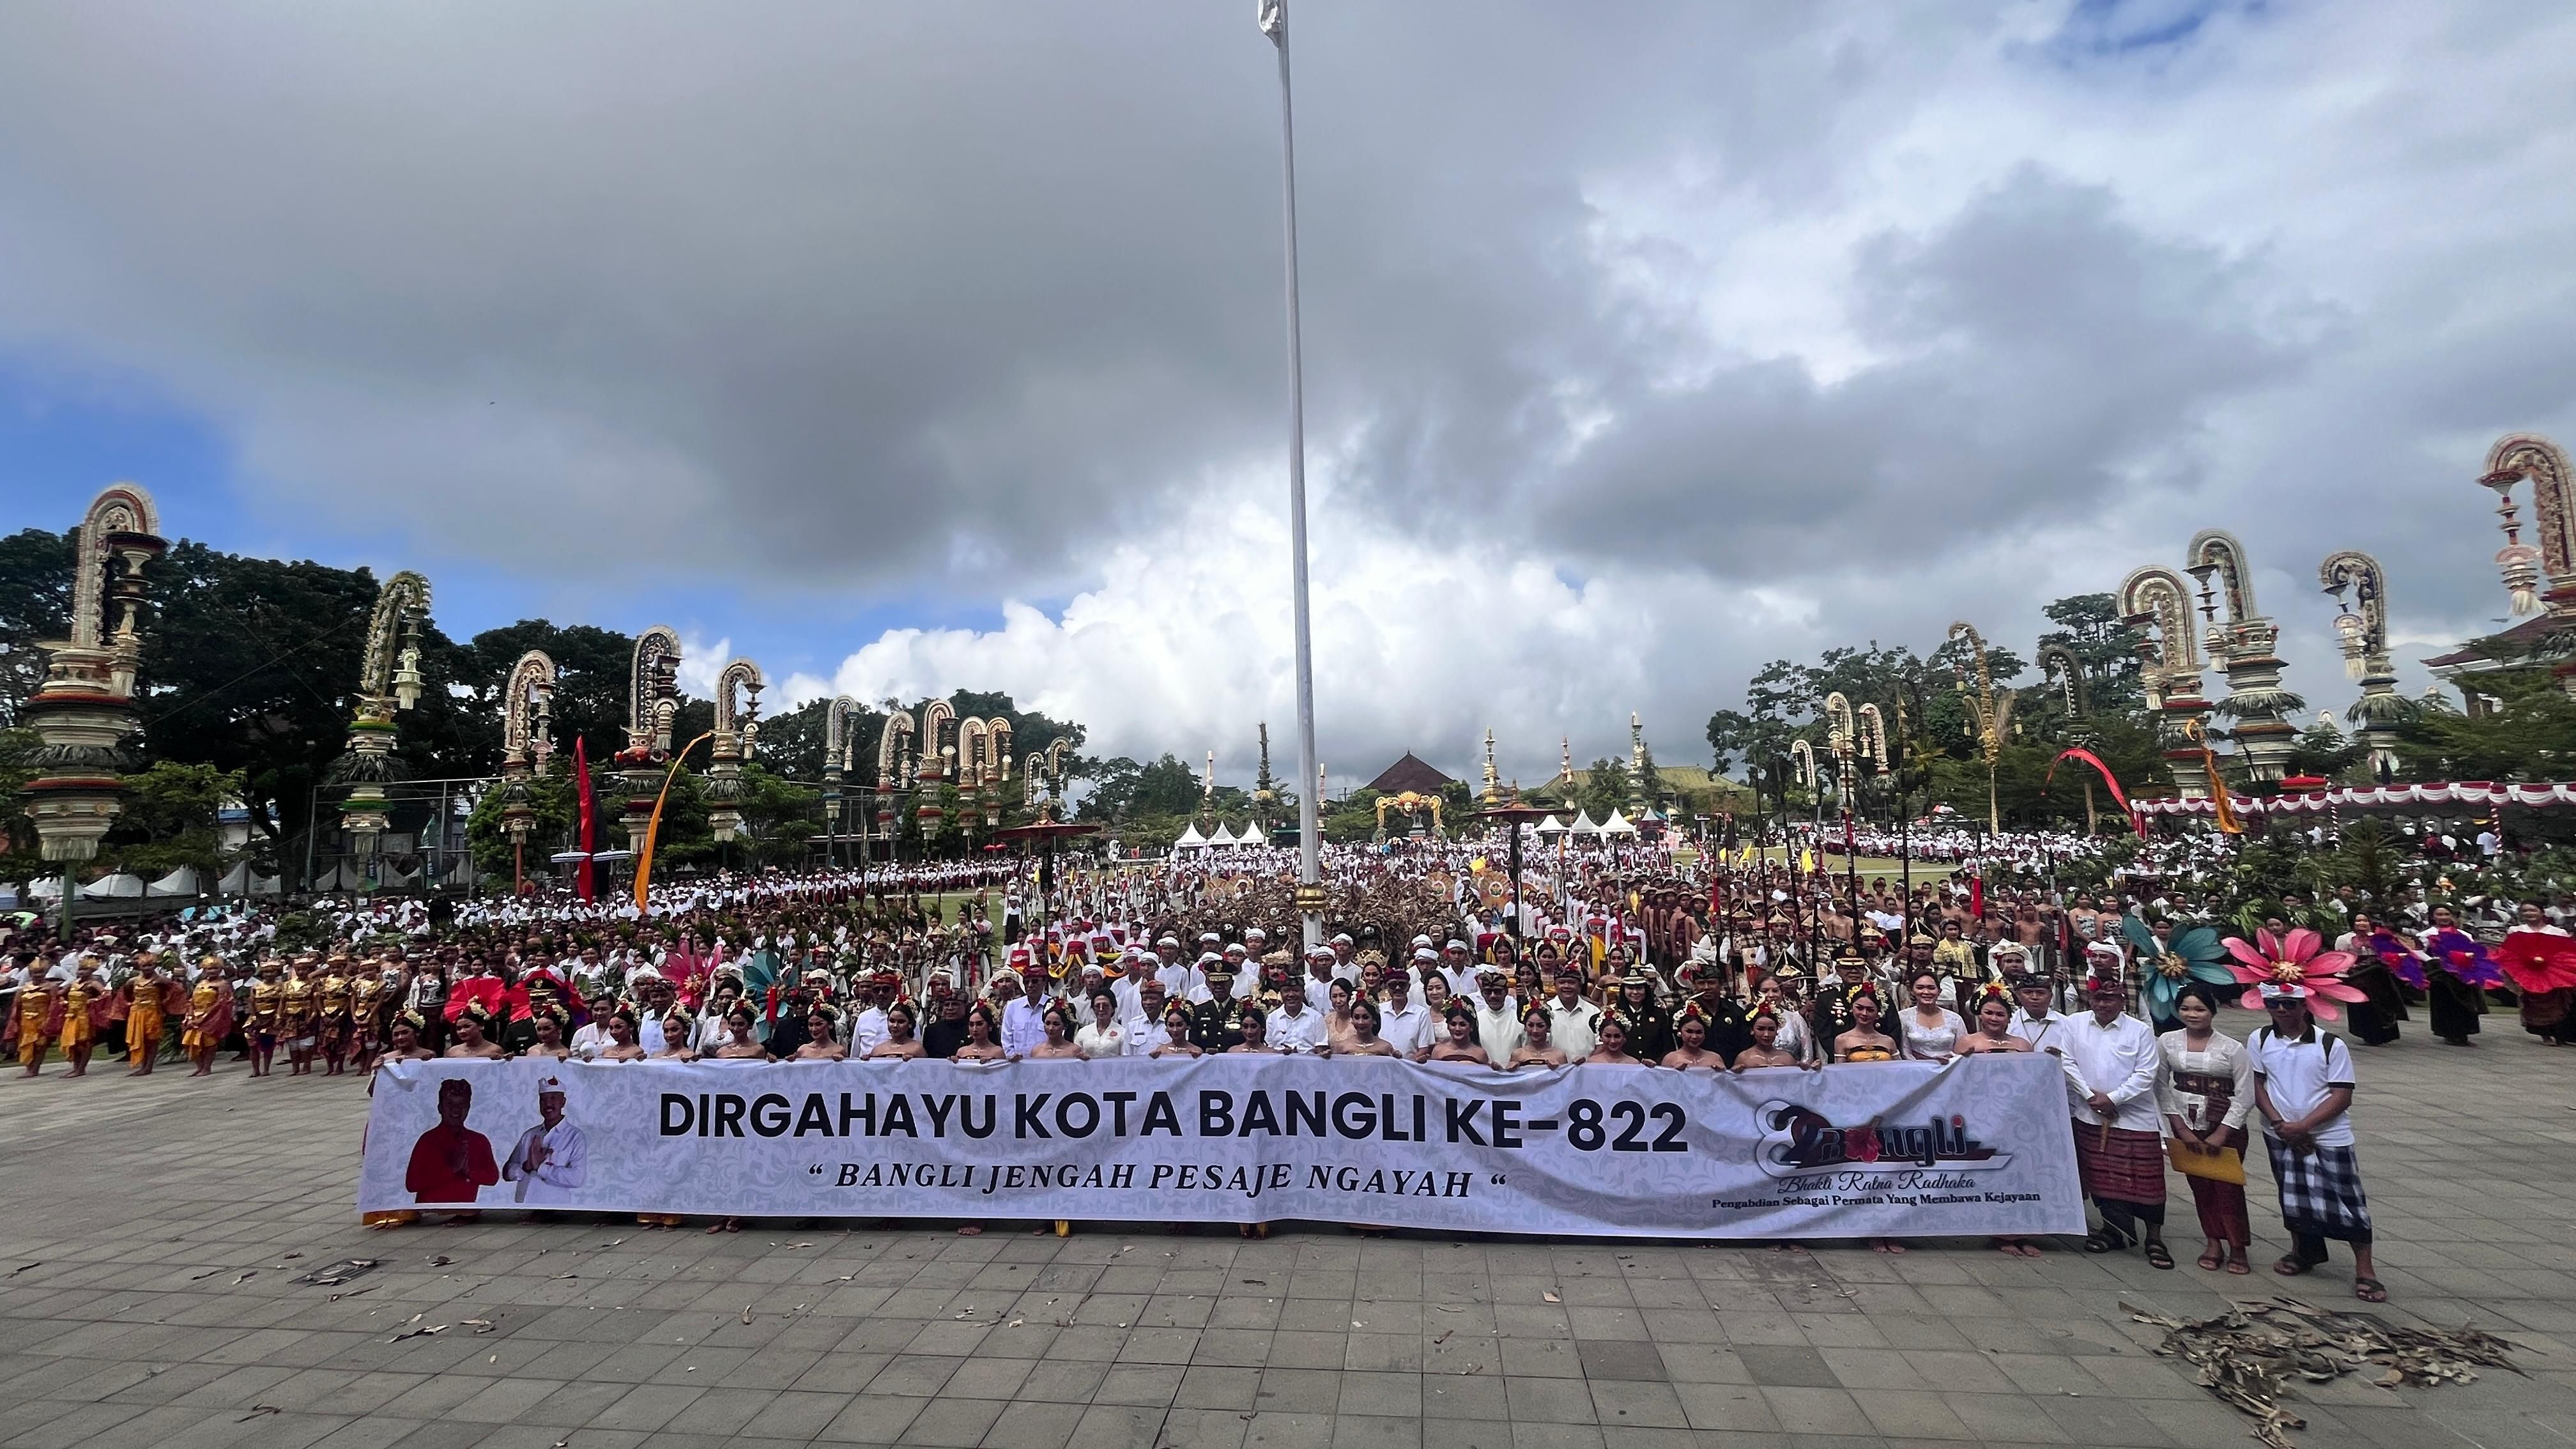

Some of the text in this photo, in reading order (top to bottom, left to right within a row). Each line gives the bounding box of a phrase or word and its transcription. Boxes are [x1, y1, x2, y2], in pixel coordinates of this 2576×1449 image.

[659, 1089, 1689, 1153] DIRGAHAYU KOTA BANGLI KE-822
[834, 1163, 977, 1188] BANGLI
[981, 1164, 1138, 1195] JENGAH
[1147, 1163, 1292, 1199] PESAJE
[1305, 1164, 1475, 1199] NGAYAH
[1777, 1170, 1975, 1193] Bhakti Ratna Radhaka
[1712, 1192, 2041, 1209] Pengabdian Sebagai Permata Yang Membawa Kejayaan
